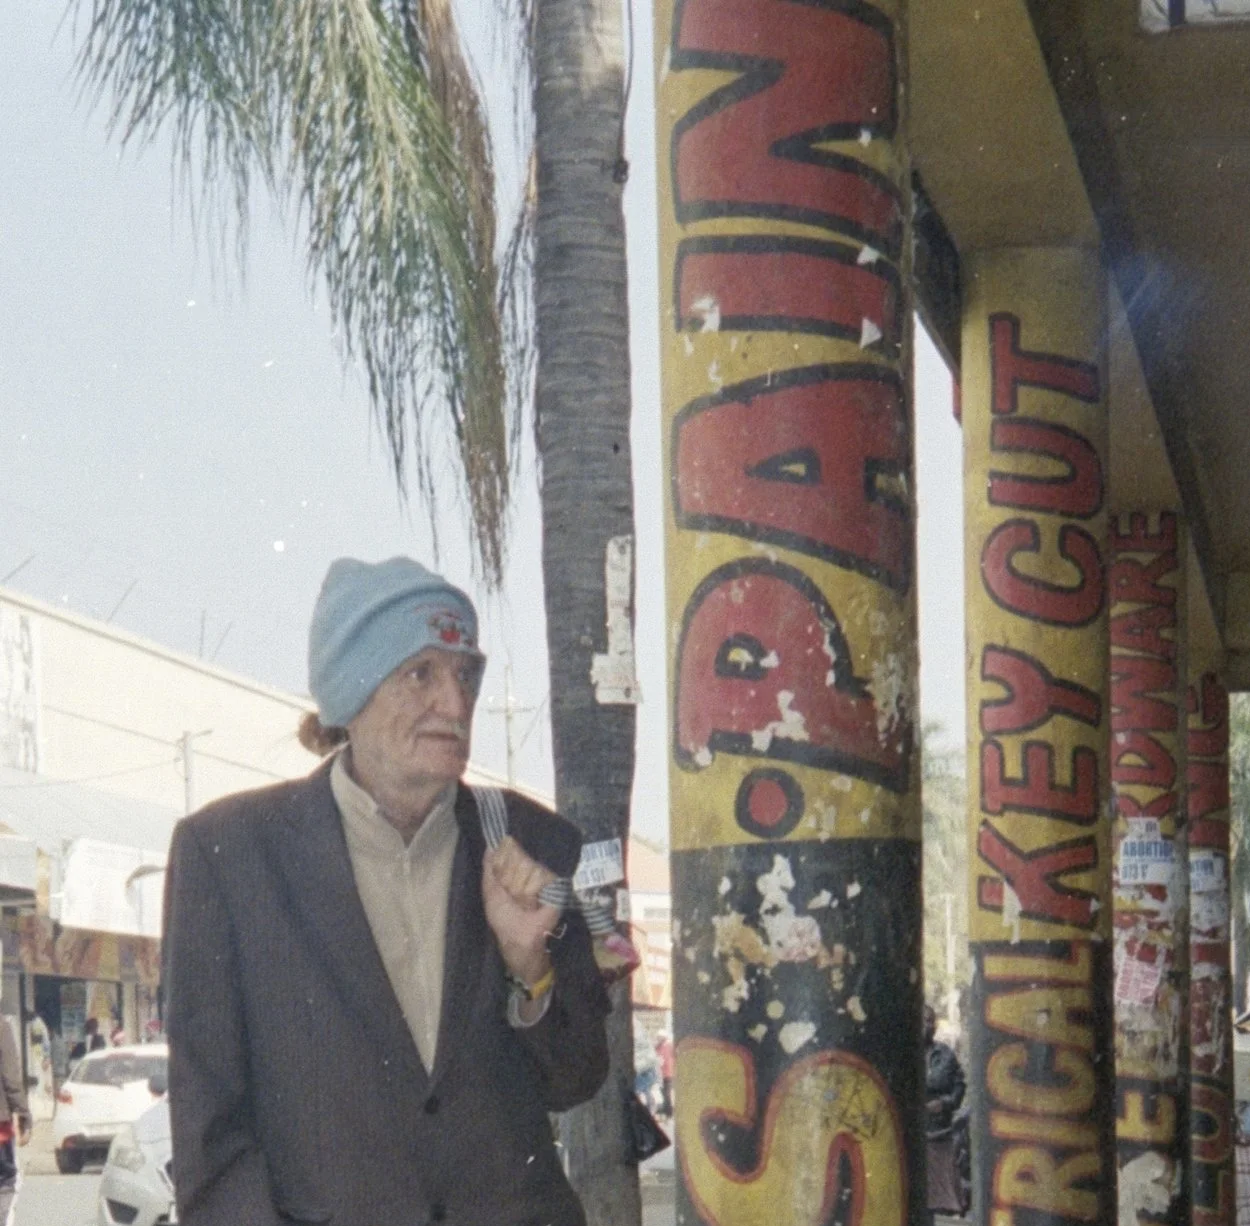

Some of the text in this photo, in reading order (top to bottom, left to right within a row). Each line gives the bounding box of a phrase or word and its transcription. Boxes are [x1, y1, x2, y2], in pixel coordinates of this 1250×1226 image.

[673, 0, 911, 793] PAIN
[979, 311, 1102, 630] CUT
[976, 641, 1100, 932] KEY
